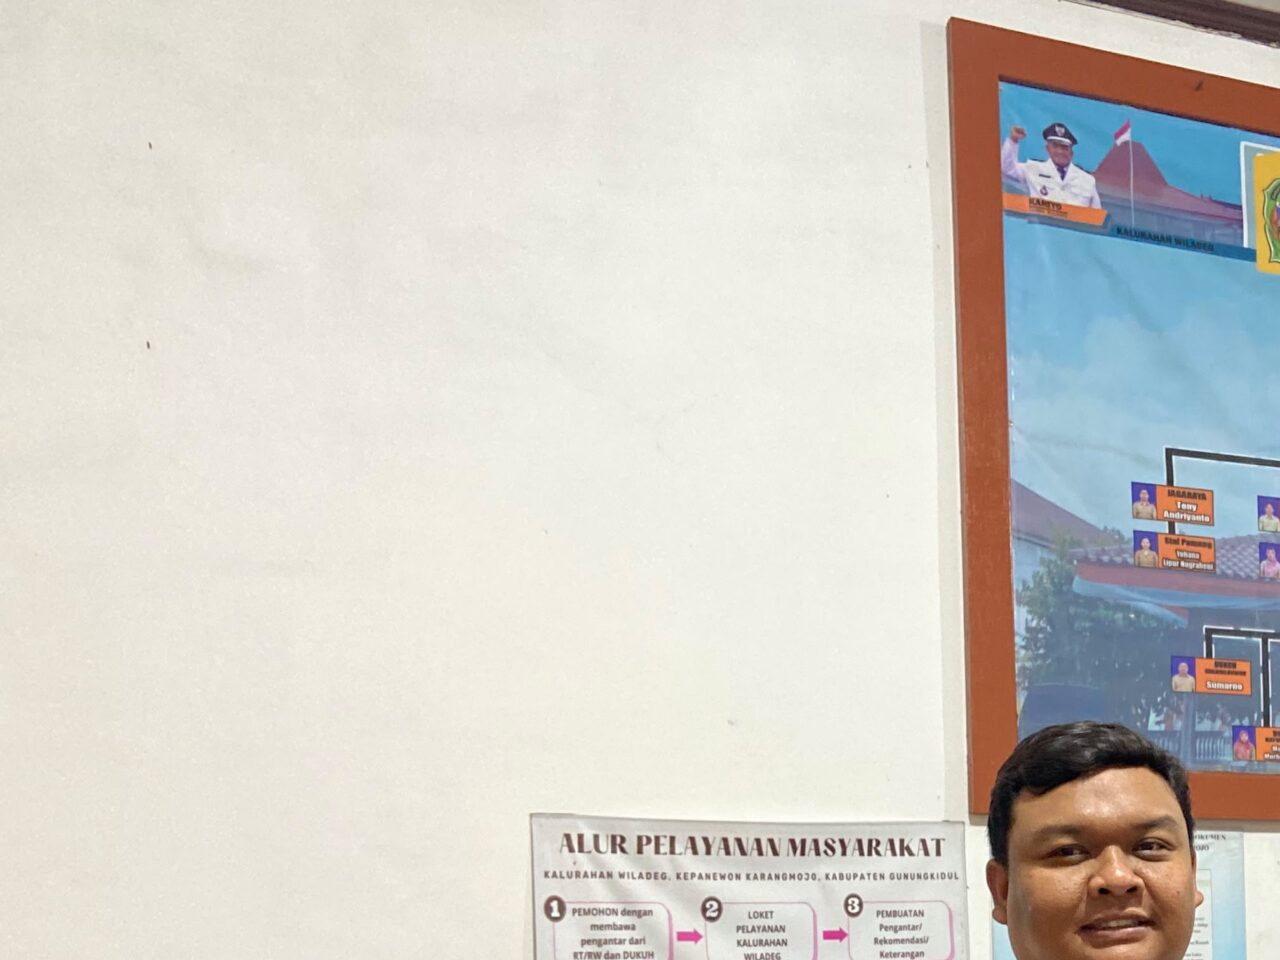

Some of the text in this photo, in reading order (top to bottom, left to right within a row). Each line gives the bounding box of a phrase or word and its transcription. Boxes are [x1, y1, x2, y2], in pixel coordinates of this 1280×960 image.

[560, 833, 946, 857] ALUR PELAYANAN MASYARAKAT
[544, 870, 613, 880] KALURAHAN
[676, 871, 741, 881] KEPANEWON
[825, 872, 885, 881] KABUPATEN
[889, 872, 959, 880] GUNUNGKIDUL
[549, 900, 561, 918] 1
[705, 900, 719, 918] 2
[847, 897, 860, 913] 3
[572, 908, 653, 919] PEMOHON dengan
[748, 911, 774, 919] LOKET
[876, 910, 925, 918] PEMBUATAN
[590, 922, 636, 931] membawa
[736, 925, 786, 933] PELAYANAN
[879, 923, 923, 932] Pengantar/
[581, 937, 646, 948] pengantar dari
[736, 939, 788, 947] KALURAHAN
[874, 937, 929, 945] Rekomendasi/
[573, 951, 655, 960] RT/RW dan DUKUH
[744, 953, 782, 960] WILADEG
[879, 950, 925, 960] Keterangan
